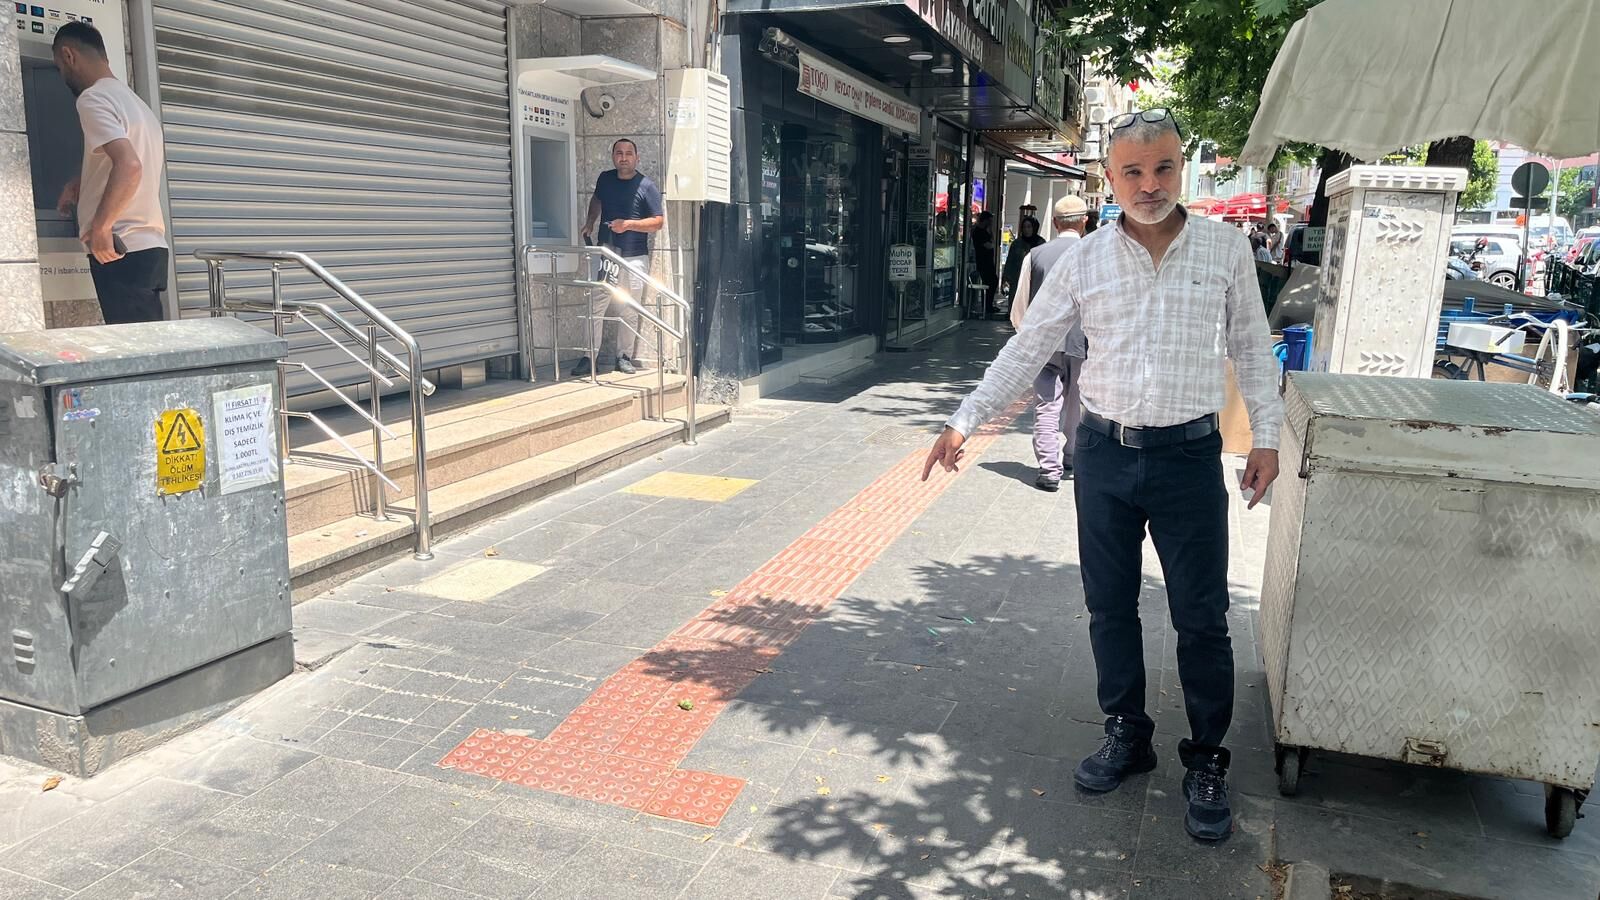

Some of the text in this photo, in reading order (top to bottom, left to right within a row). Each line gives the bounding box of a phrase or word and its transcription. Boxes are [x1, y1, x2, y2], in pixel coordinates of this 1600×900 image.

[943, 3, 983, 62] AYAKKABI
[810, 67, 829, 92] TOGO
[889, 248, 913, 259] Muhip
[231, 399, 252, 409] FIRSAT
[224, 414, 245, 424] KLİMA
[253, 409, 262, 419] VE
[224, 422, 264, 438] DIŞ TEMİZLİK
[233, 437, 257, 449] SADECE
